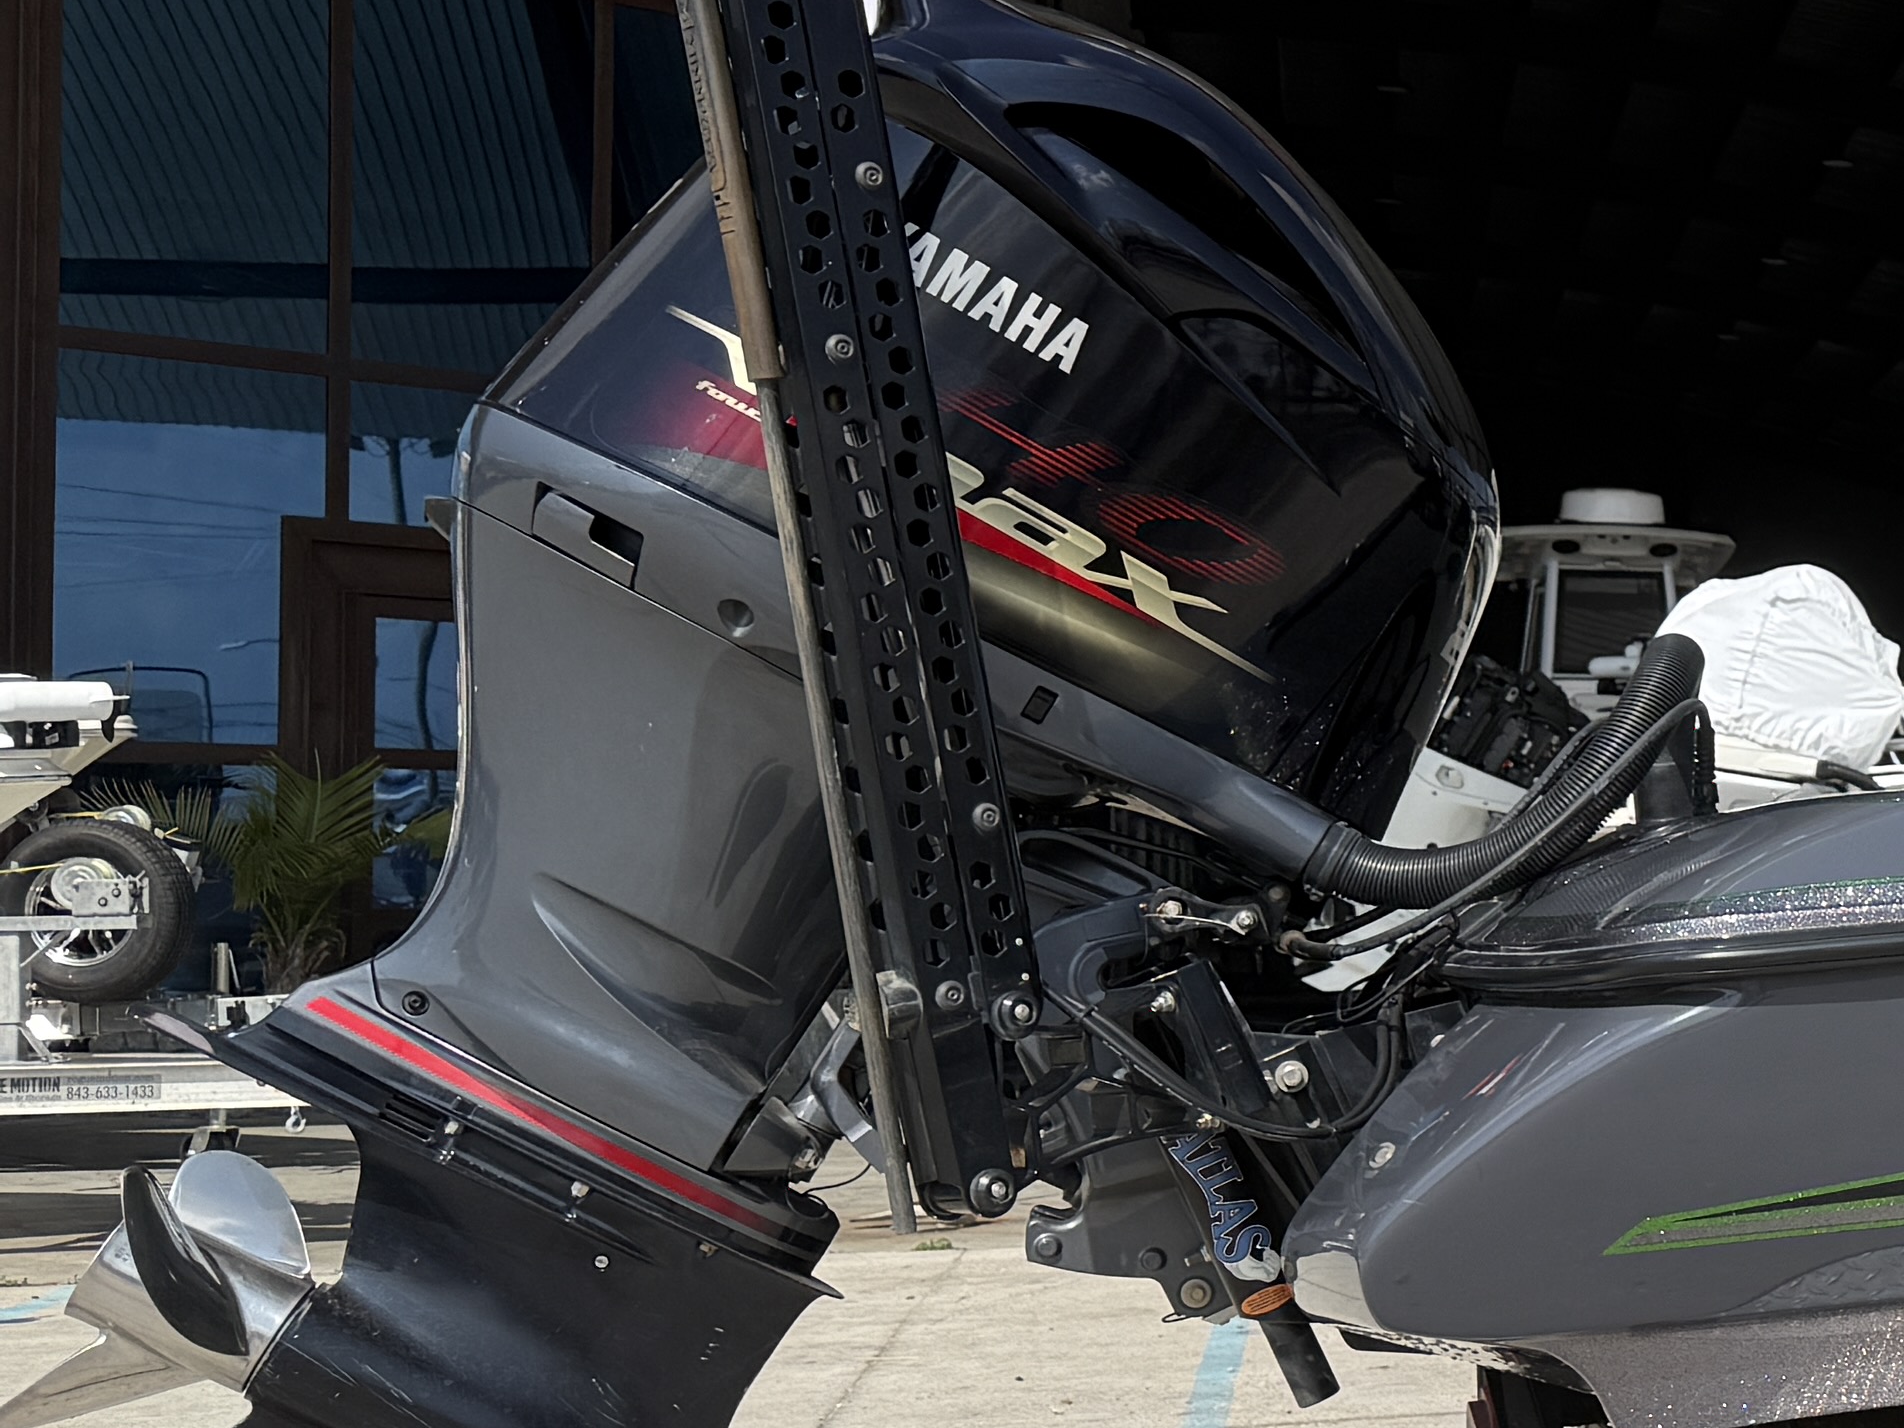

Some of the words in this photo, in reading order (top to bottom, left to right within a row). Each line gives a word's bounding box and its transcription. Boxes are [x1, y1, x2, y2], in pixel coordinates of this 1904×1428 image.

[904, 222, 1090, 375] AMAHA
[10, 1076, 61, 1094] MOTION
[66, 1084, 155, 1100] 843-633-1433
